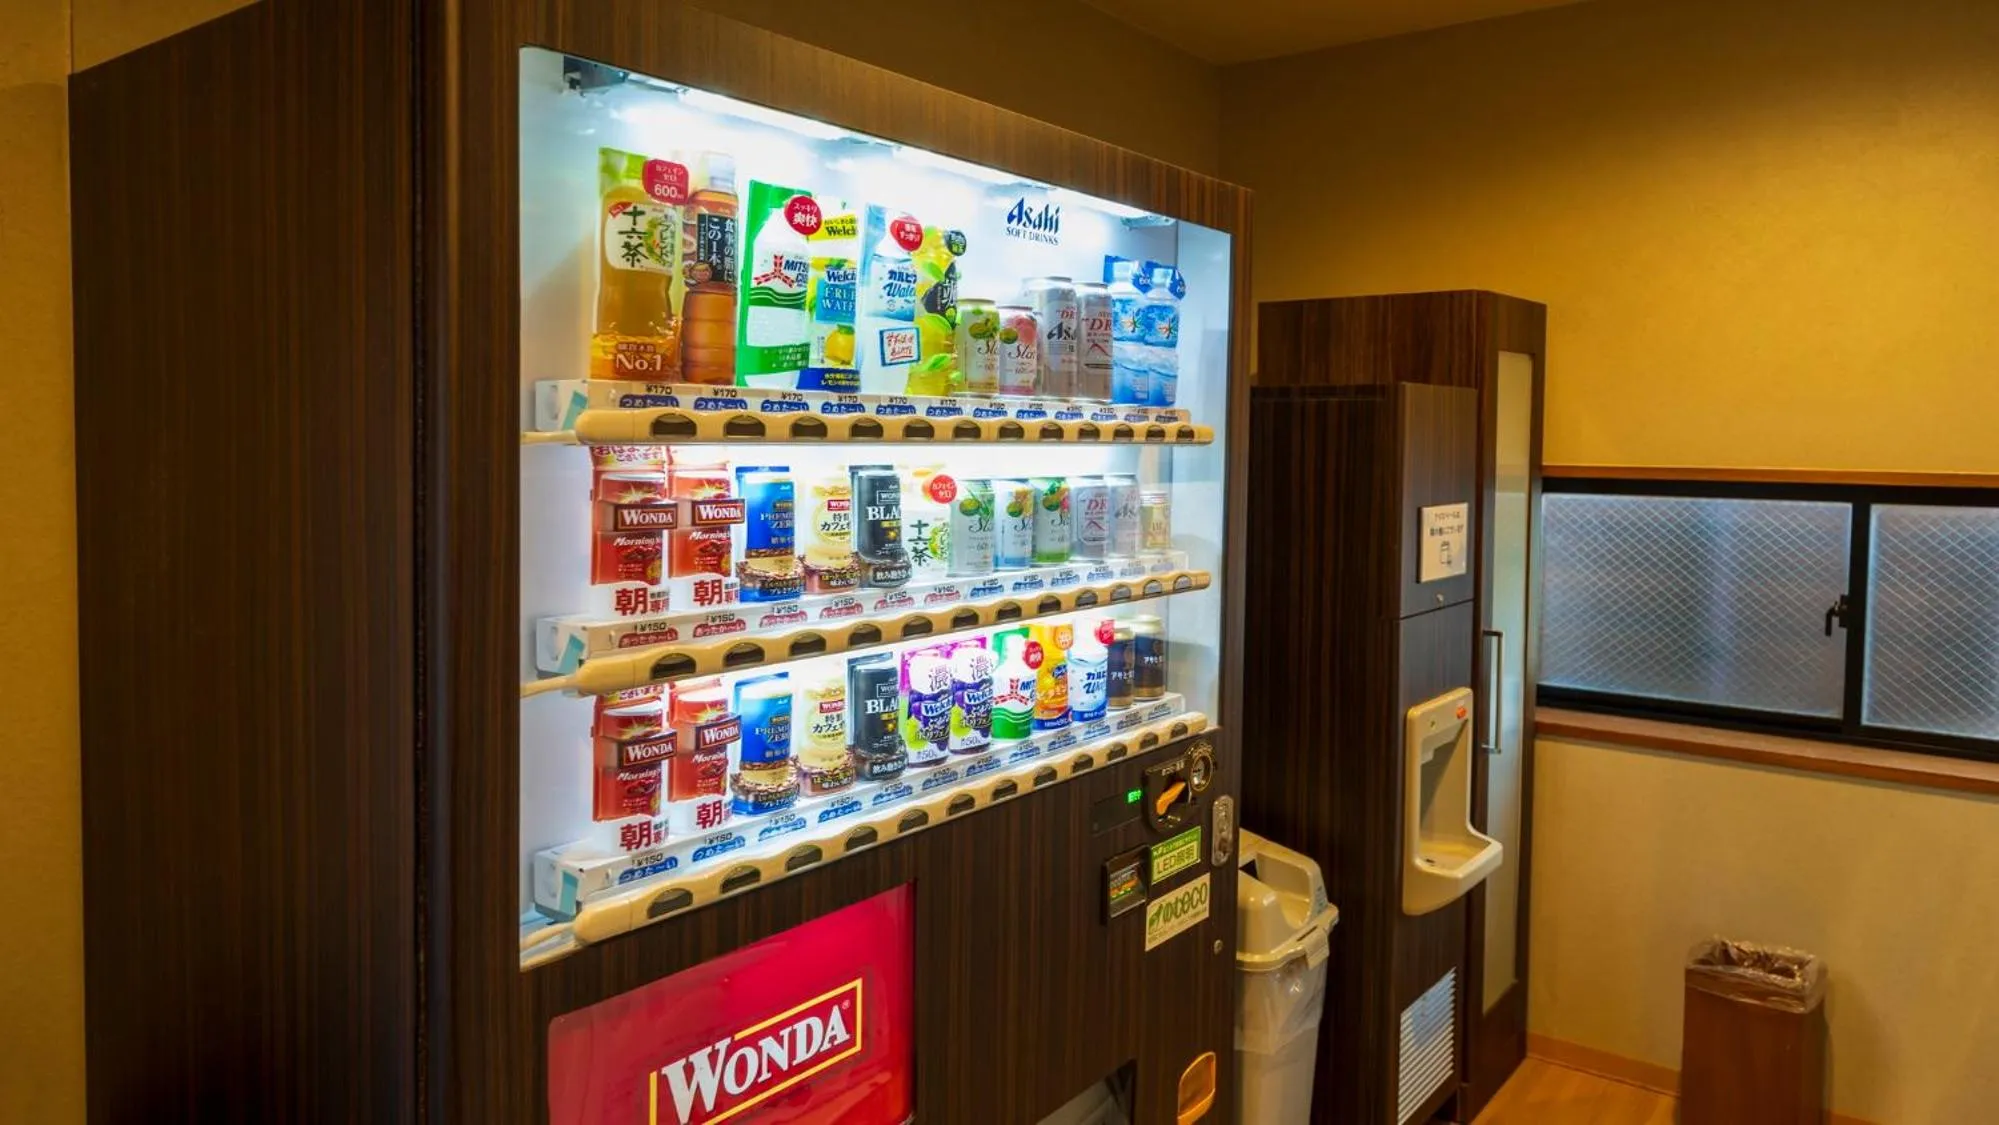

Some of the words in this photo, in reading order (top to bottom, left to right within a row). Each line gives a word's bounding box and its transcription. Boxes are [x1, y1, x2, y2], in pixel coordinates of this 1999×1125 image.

[1007, 197, 1060, 235] Asahi
[617, 205, 650, 268] 十六茶
[1006, 226, 1028, 239] SOFT
[1029, 231, 1060, 246] DRINKS
[1007, 343, 1036, 360] Sla
[616, 354, 663, 371] No.1
[645, 383, 673, 395] ¥170
[712, 387, 738, 398] ¥170
[781, 390, 804, 401] ¥170
[622, 509, 673, 525] WONDA
[699, 504, 742, 519] WONDA
[866, 505, 901, 520] BLA
[907, 519, 934, 566] 十六茶
[615, 587, 649, 616] 朝
[693, 579, 723, 607] 朝
[710, 612, 735, 623] ¥150
[639, 621, 667, 633] ¥150
[702, 725, 739, 745] WONDA
[626, 741, 673, 762] WONDA
[696, 799, 723, 829] 朝
[620, 820, 653, 852] 朝
[707, 832, 733, 845] ¥150
[635, 852, 664, 866] ¥150
[661, 1004, 851, 1125] WONDA
